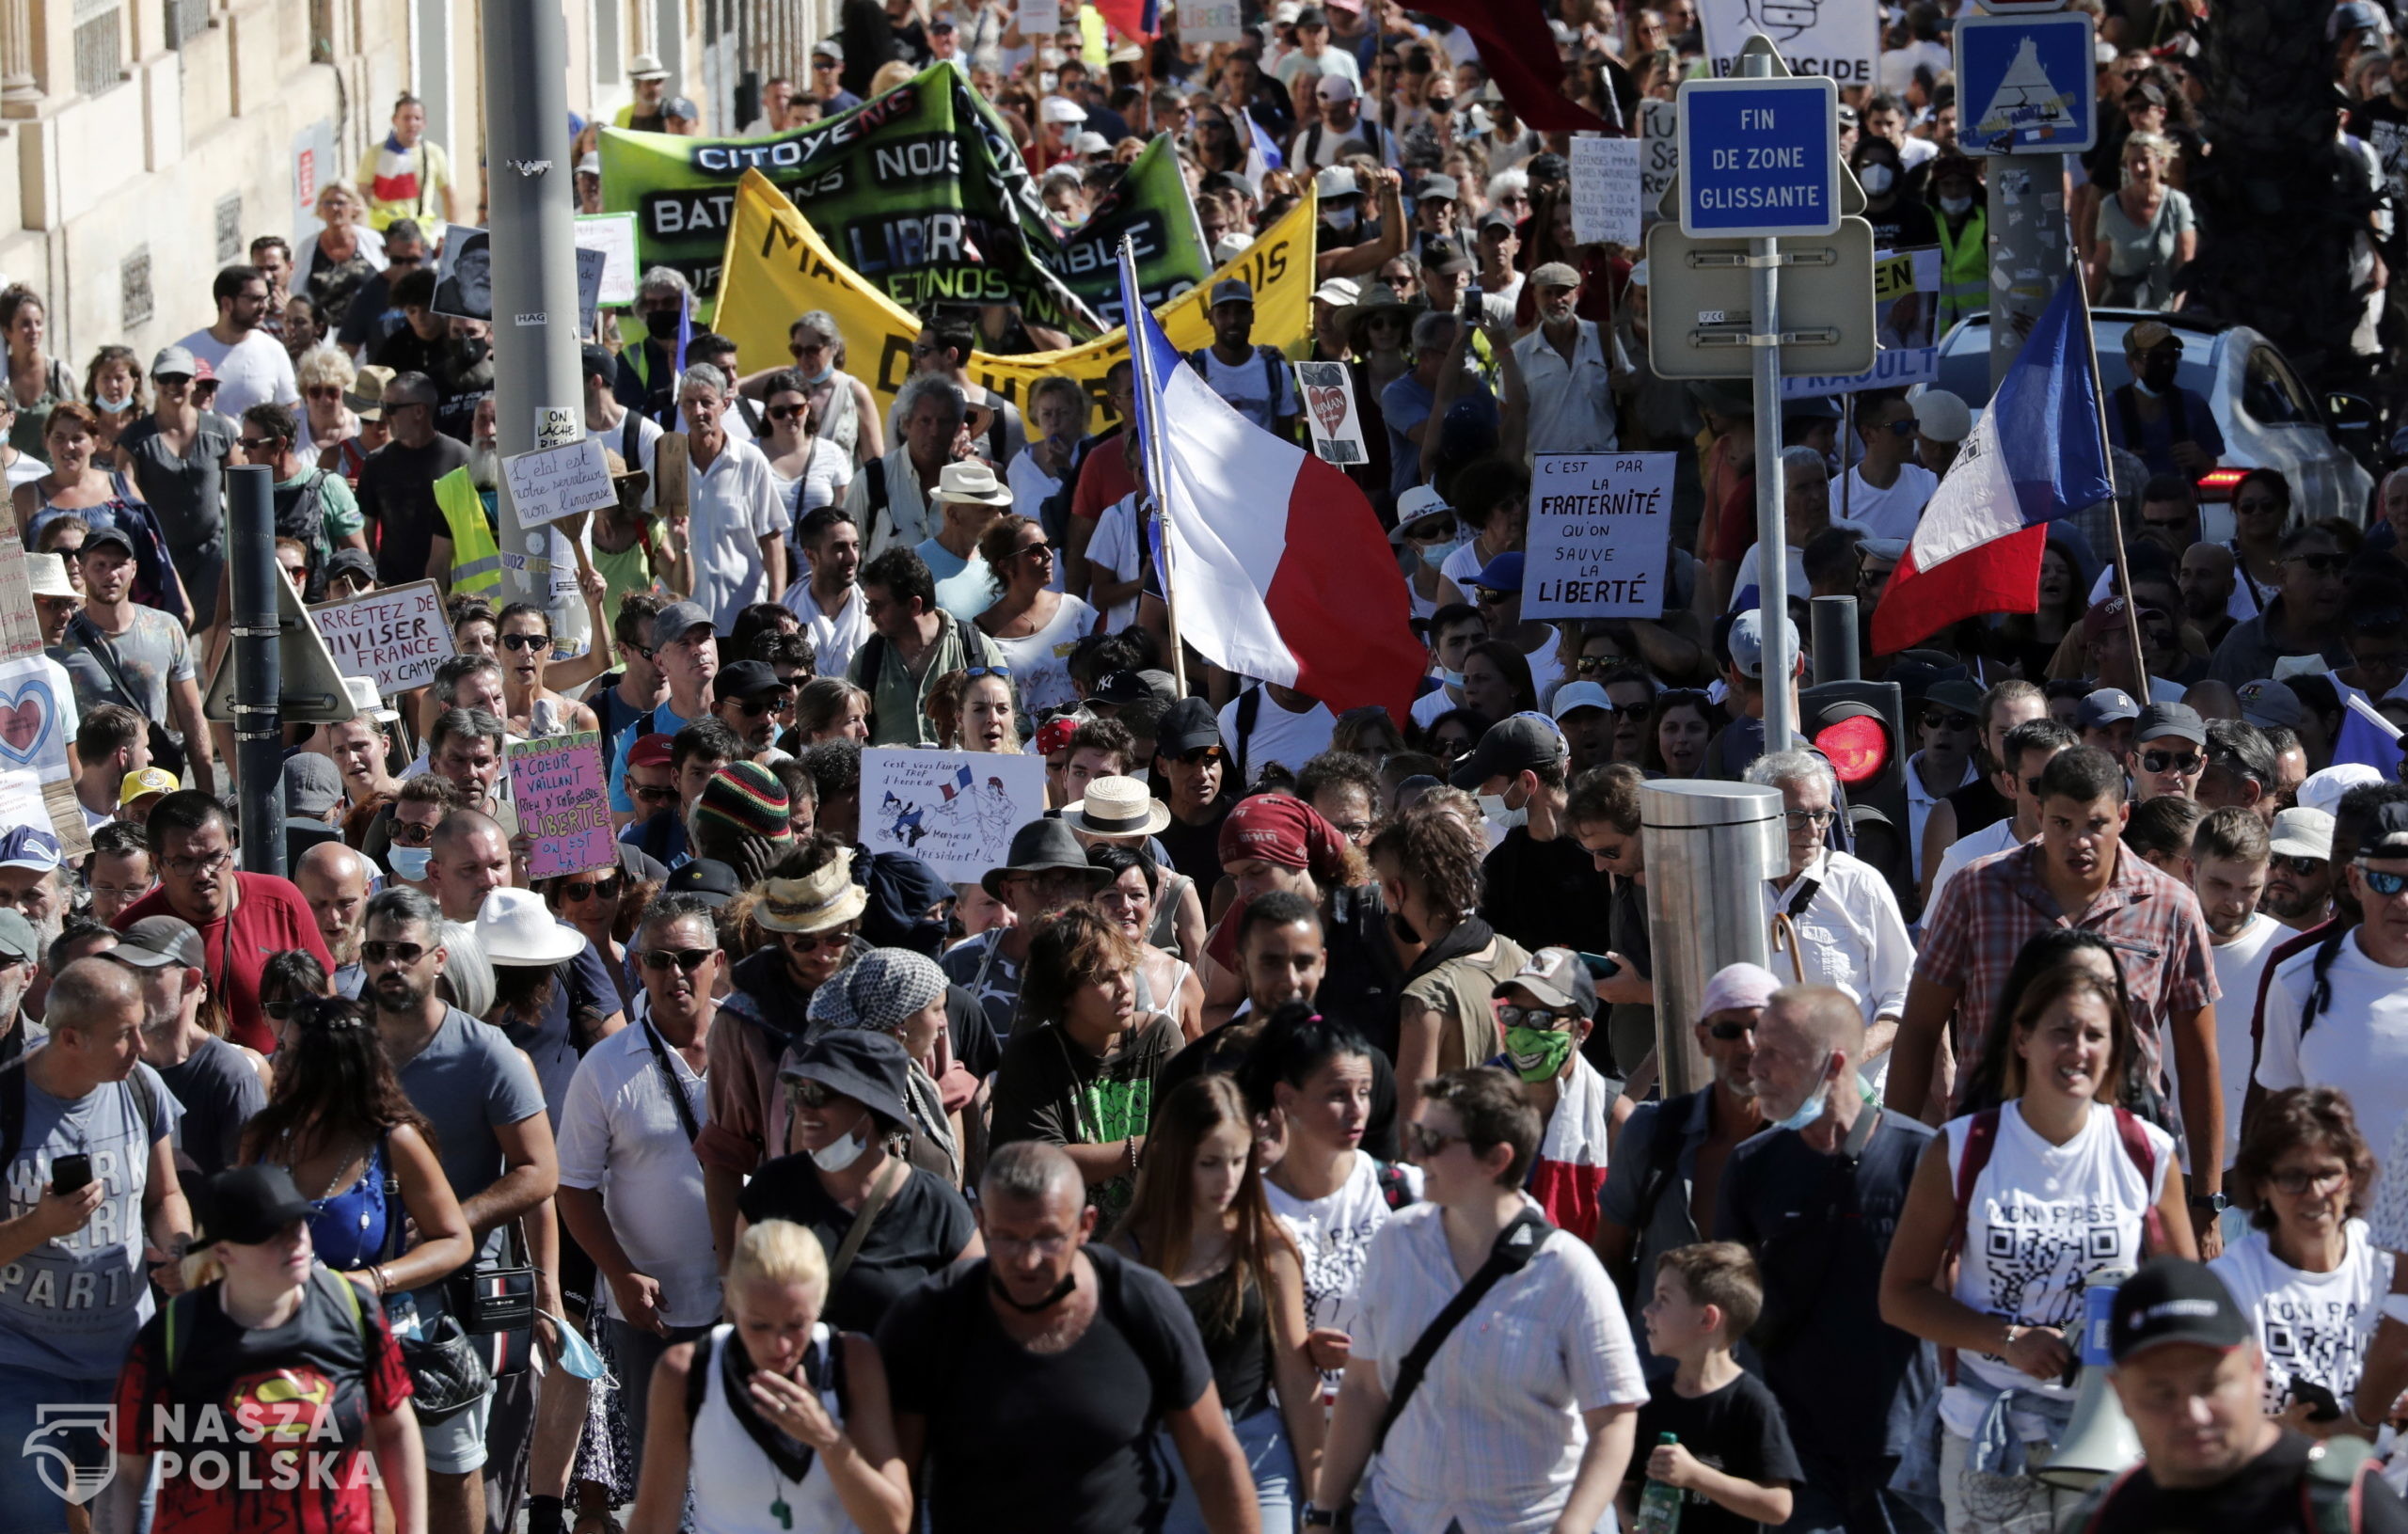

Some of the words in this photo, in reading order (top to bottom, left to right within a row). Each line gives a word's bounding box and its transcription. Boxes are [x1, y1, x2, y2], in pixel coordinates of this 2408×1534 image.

[1741, 108, 1775, 131] FIN
[876, 139, 961, 181] NOUS
[1713, 149, 1740, 170] DE
[1747, 147, 1805, 169] ZONE
[1700, 185, 1819, 210] GLISSANTE
[927, 268, 1010, 299] NOS
[549, 411, 567, 421] ON
[537, 422, 577, 437] LÂCHE
[1545, 460, 1589, 474] C'EST
[1615, 459, 1643, 473] PAR
[1592, 479, 1608, 490] LA
[519, 501, 552, 521] non
[1561, 520, 1610, 537] QU'ON
[1555, 546, 1615, 561] SAUVE
[1580, 565, 1599, 577] LA
[415, 594, 436, 612] DE
[356, 637, 439, 669] FRANCE
[512, 763, 522, 779] A
[528, 752, 571, 776] COEUR
[543, 840, 562, 854] ON
[569, 831, 594, 849] EST
[8, 1140, 147, 1205] WRK
[1988, 1203, 2037, 1223] MON
[2053, 1203, 2117, 1224] PASS
